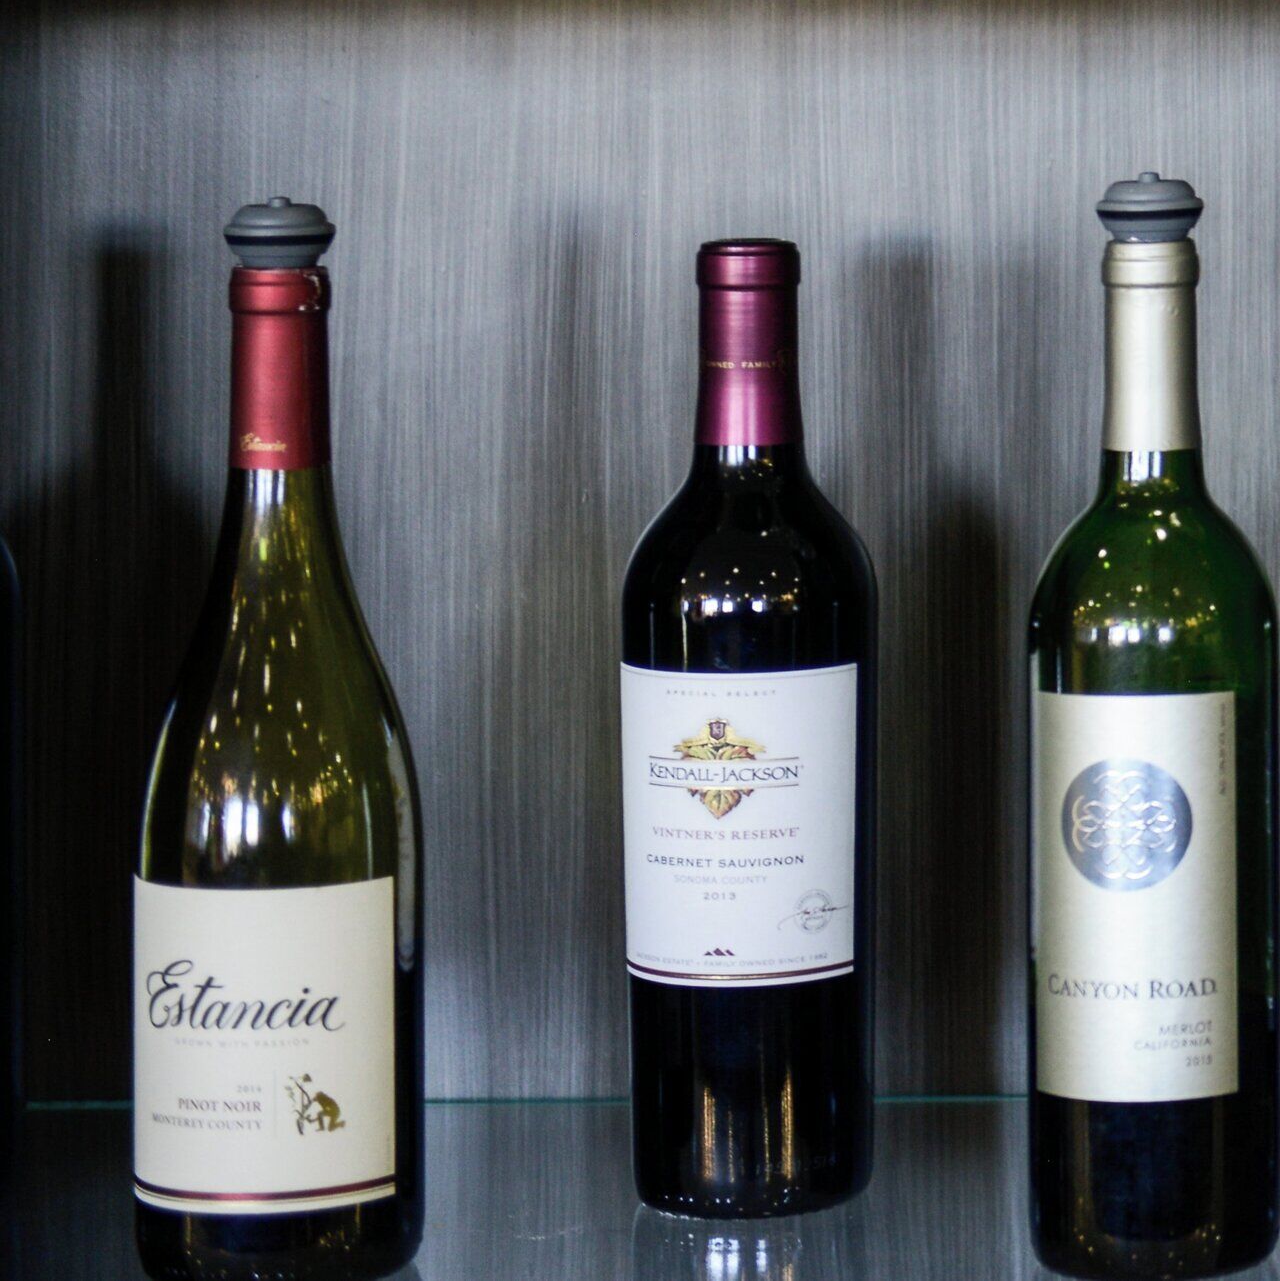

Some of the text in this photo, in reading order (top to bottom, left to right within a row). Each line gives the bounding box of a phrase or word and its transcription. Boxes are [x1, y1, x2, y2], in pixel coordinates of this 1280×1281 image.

[665, 689, 777, 697] SPECIAL SELECT
[650, 762, 799, 784] KENDALL-JACKSON
[652, 826, 798, 841] VINTNER'S RESERVE
[646, 854, 804, 868] CABERNET SAUVIGNON
[674, 875, 768, 885] SONOMA COUNTY
[703, 892, 737, 900] 2013
[1048, 973, 1217, 1000] CANYON ROAD
[146, 959, 346, 1032] Estancia
[1158, 1020, 1213, 1036] MERLOT
[1134, 1038, 1212, 1051] CALIFORNIA
[178, 1098, 262, 1113] PINOT NOIR
